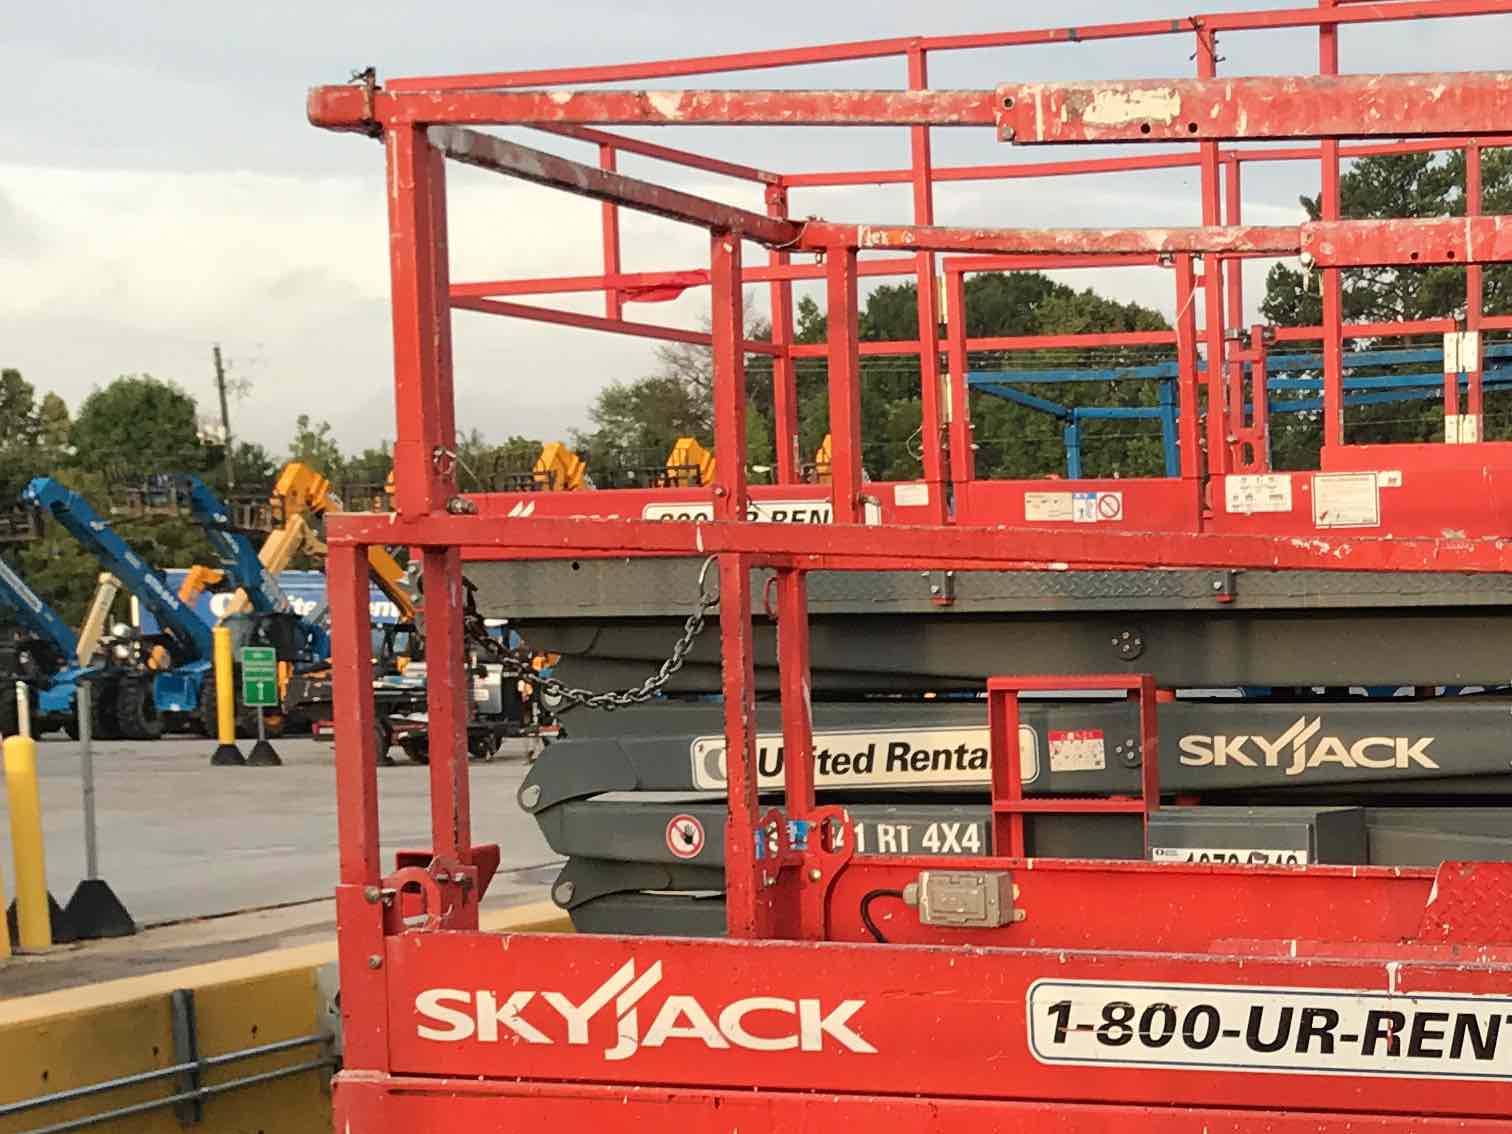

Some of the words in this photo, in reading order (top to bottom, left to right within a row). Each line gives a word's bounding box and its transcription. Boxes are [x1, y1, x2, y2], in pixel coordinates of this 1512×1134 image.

[758, 742, 875, 777] Uted
[885, 741, 991, 773] Renta
[1178, 715, 1440, 776] SKYJACK
[877, 823, 912, 854] RT
[921, 821, 981, 854] 4X4
[415, 956, 879, 1061] SKYJACK
